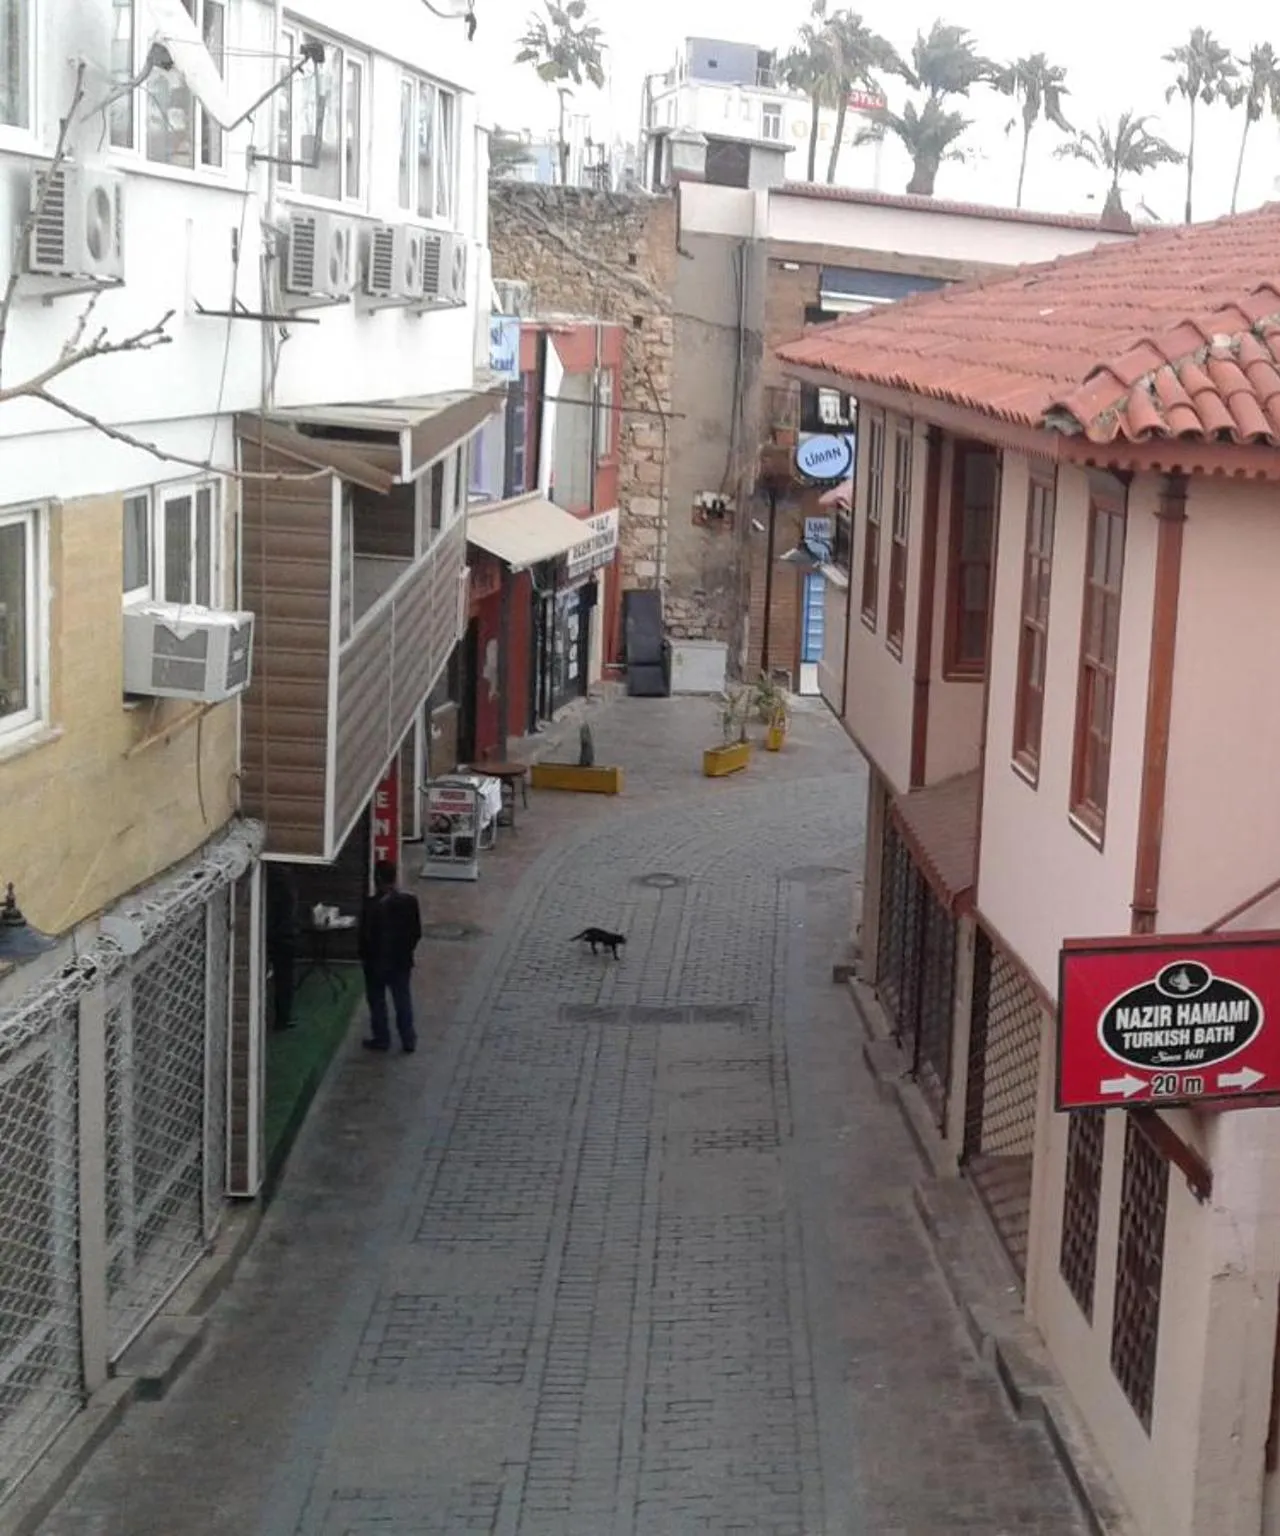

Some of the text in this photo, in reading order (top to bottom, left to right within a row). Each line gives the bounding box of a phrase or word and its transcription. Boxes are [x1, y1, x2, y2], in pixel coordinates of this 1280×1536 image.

[373, 763, 391, 862] ENT
[1116, 999, 1250, 1030] NAZIR HAMAMI
[1123, 1026, 1235, 1049] TURKISH BATH
[1152, 1074, 1204, 1096] 20 m
